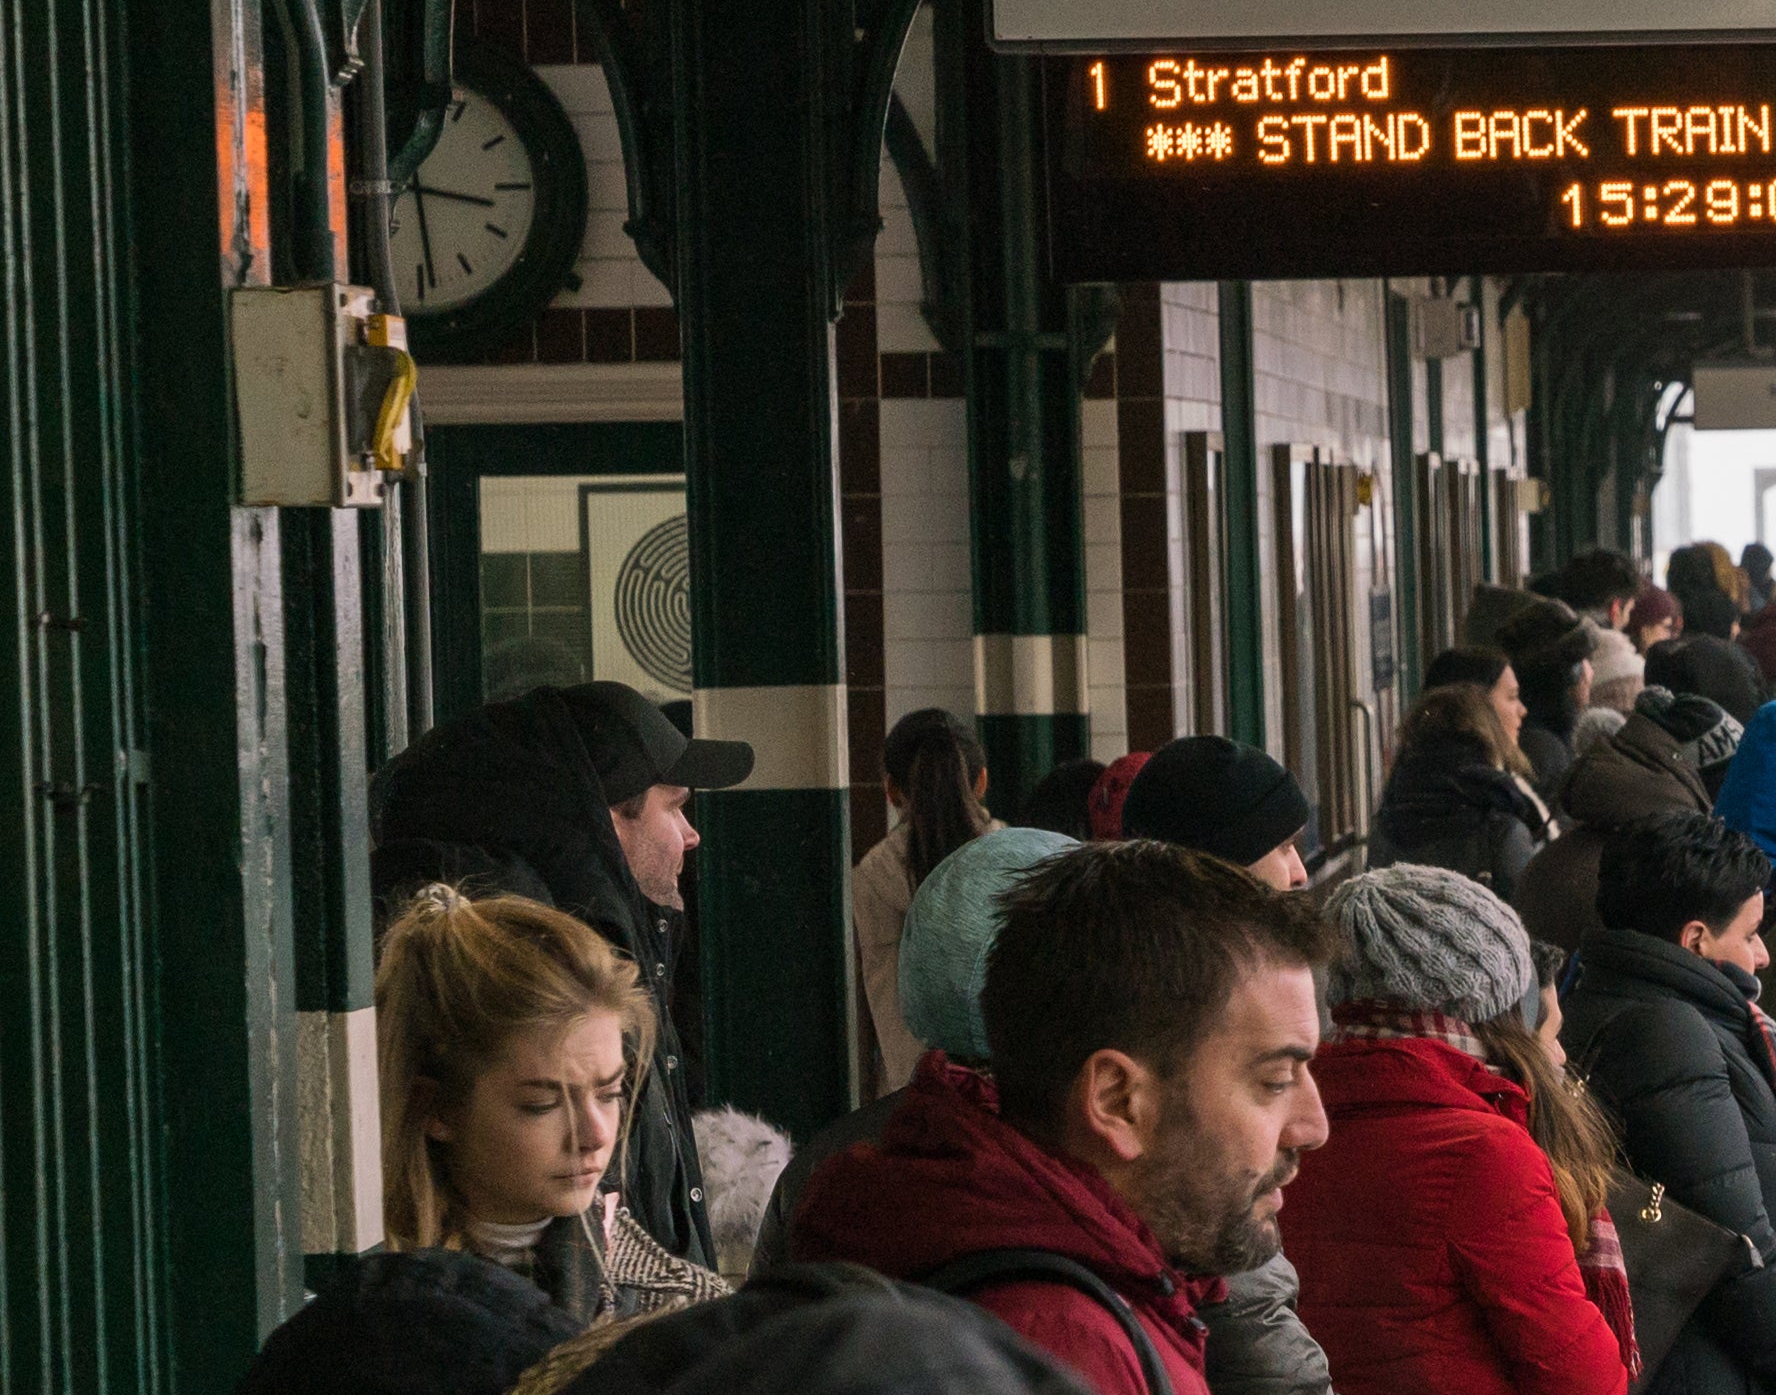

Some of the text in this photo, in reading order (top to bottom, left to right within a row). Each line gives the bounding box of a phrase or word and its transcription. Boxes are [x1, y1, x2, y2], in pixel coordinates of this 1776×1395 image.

[1089, 56, 1391, 110] 1 Stratford
[1256, 113, 1430, 164] STAND
[1454, 108, 1590, 160] BACK
[1612, 103, 1771, 156] TRAIN
